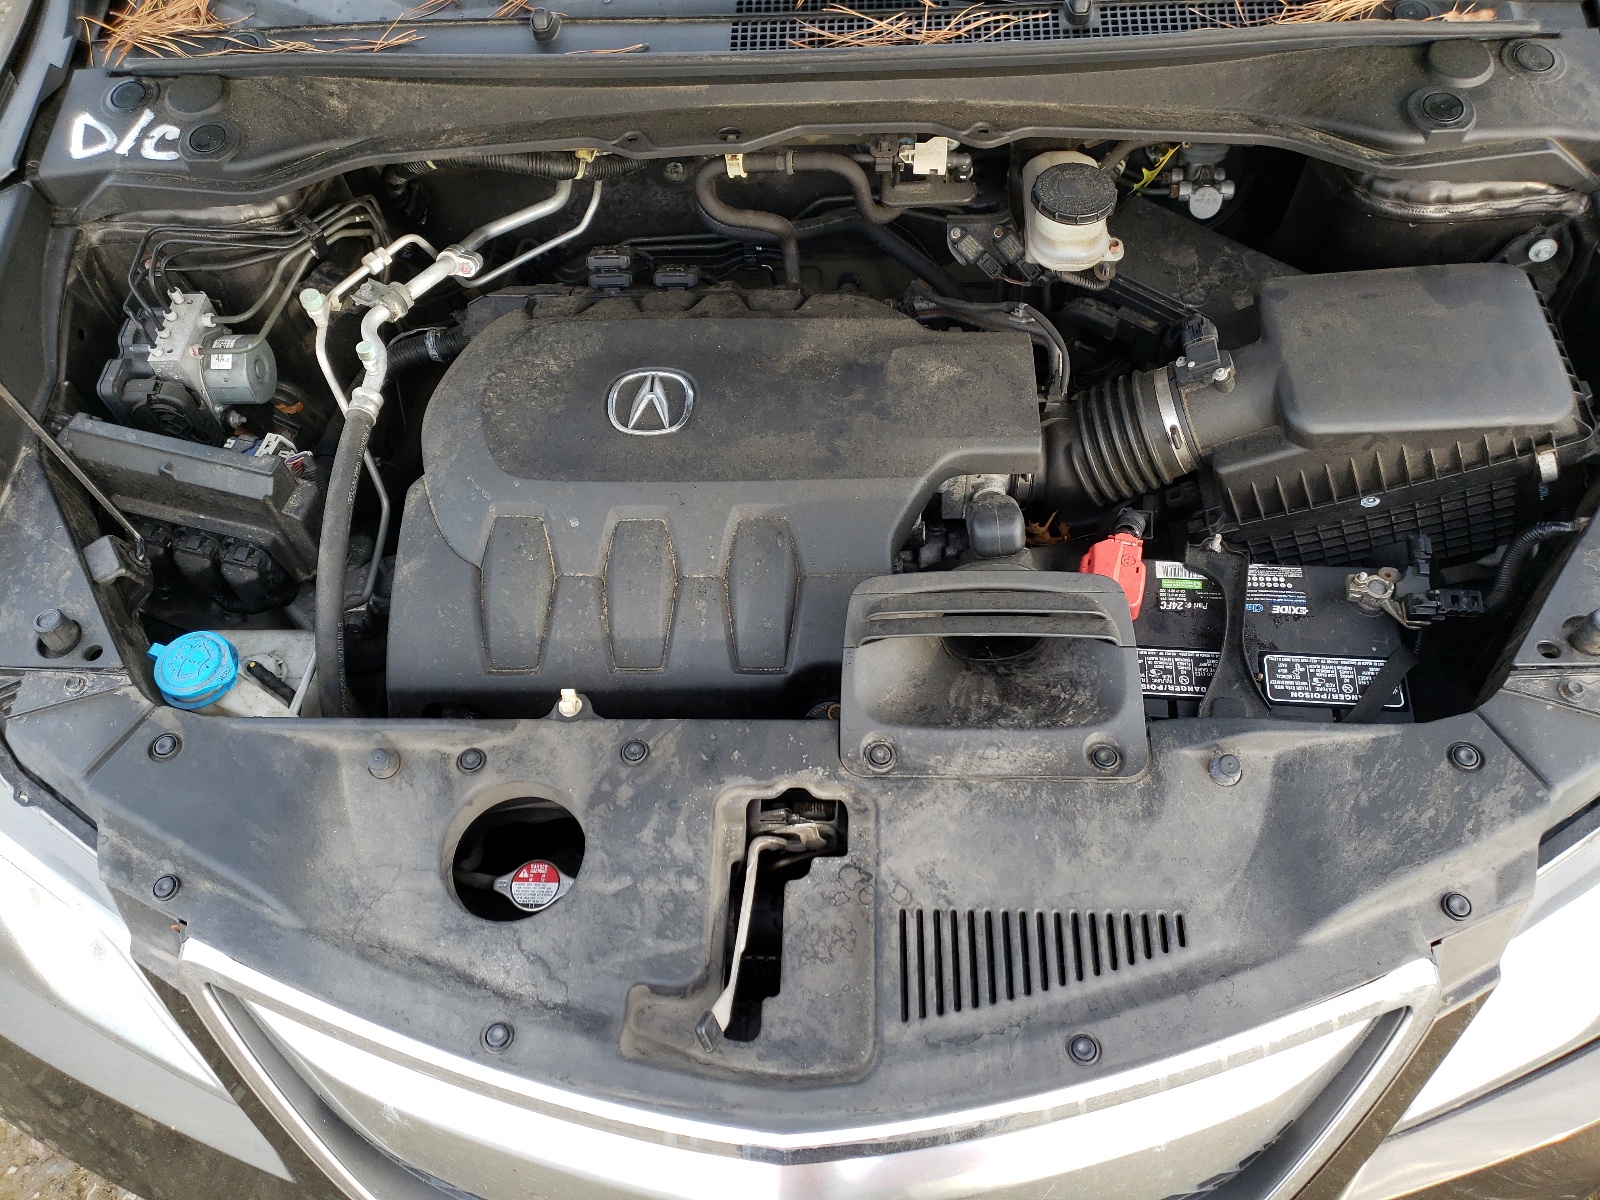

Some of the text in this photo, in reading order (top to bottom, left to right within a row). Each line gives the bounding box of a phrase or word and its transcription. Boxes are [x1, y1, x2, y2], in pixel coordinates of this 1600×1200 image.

[70, 108, 181, 161] D/C
[1160, 601, 1184, 610] 24FC
[1193, 602, 1209, 610] Part
[1272, 605, 1309, 615] EXIDE
